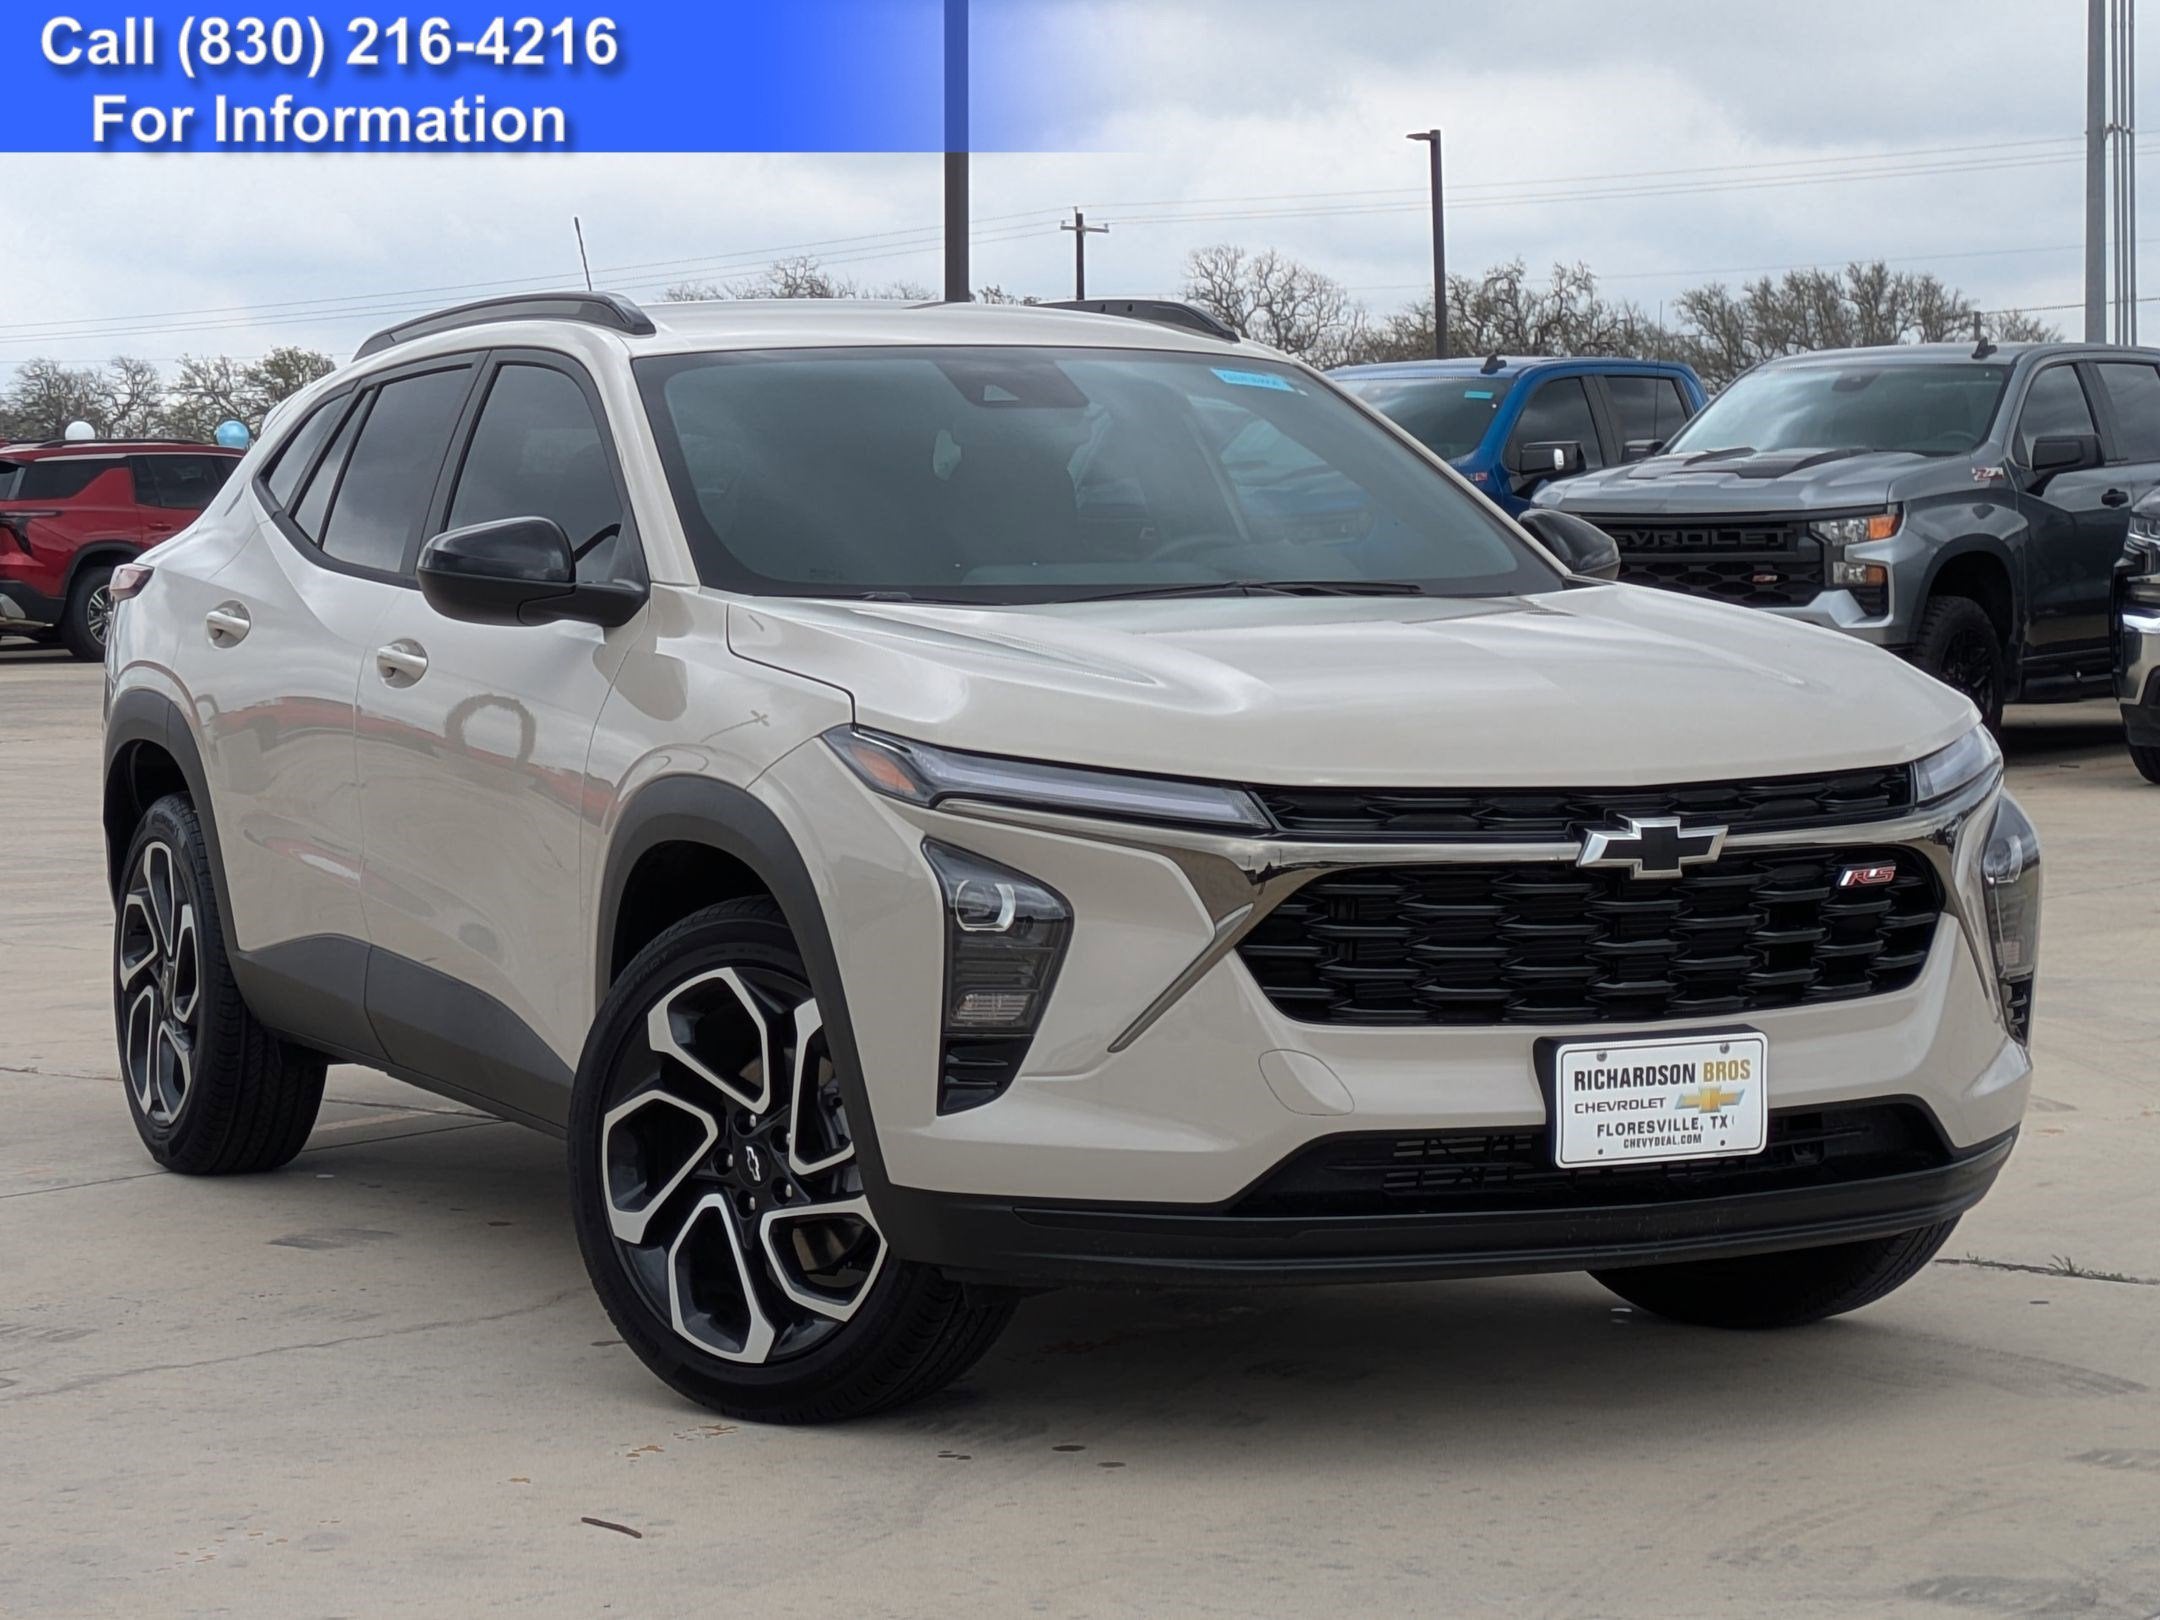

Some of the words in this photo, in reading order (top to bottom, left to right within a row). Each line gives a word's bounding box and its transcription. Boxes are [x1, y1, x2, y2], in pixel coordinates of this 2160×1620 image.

[1840, 866, 1896, 886] RS
[1574, 1063, 1696, 1092] RICHARDSON
[1703, 1059, 1751, 1083] BROS
[1574, 1097, 1666, 1114] CHEVROLET
[1597, 1117, 1704, 1138] FLORESVILLE,
[1710, 1114, 1728, 1129] TX
[1623, 1133, 1702, 1149] CHEVYDEAL.COM
